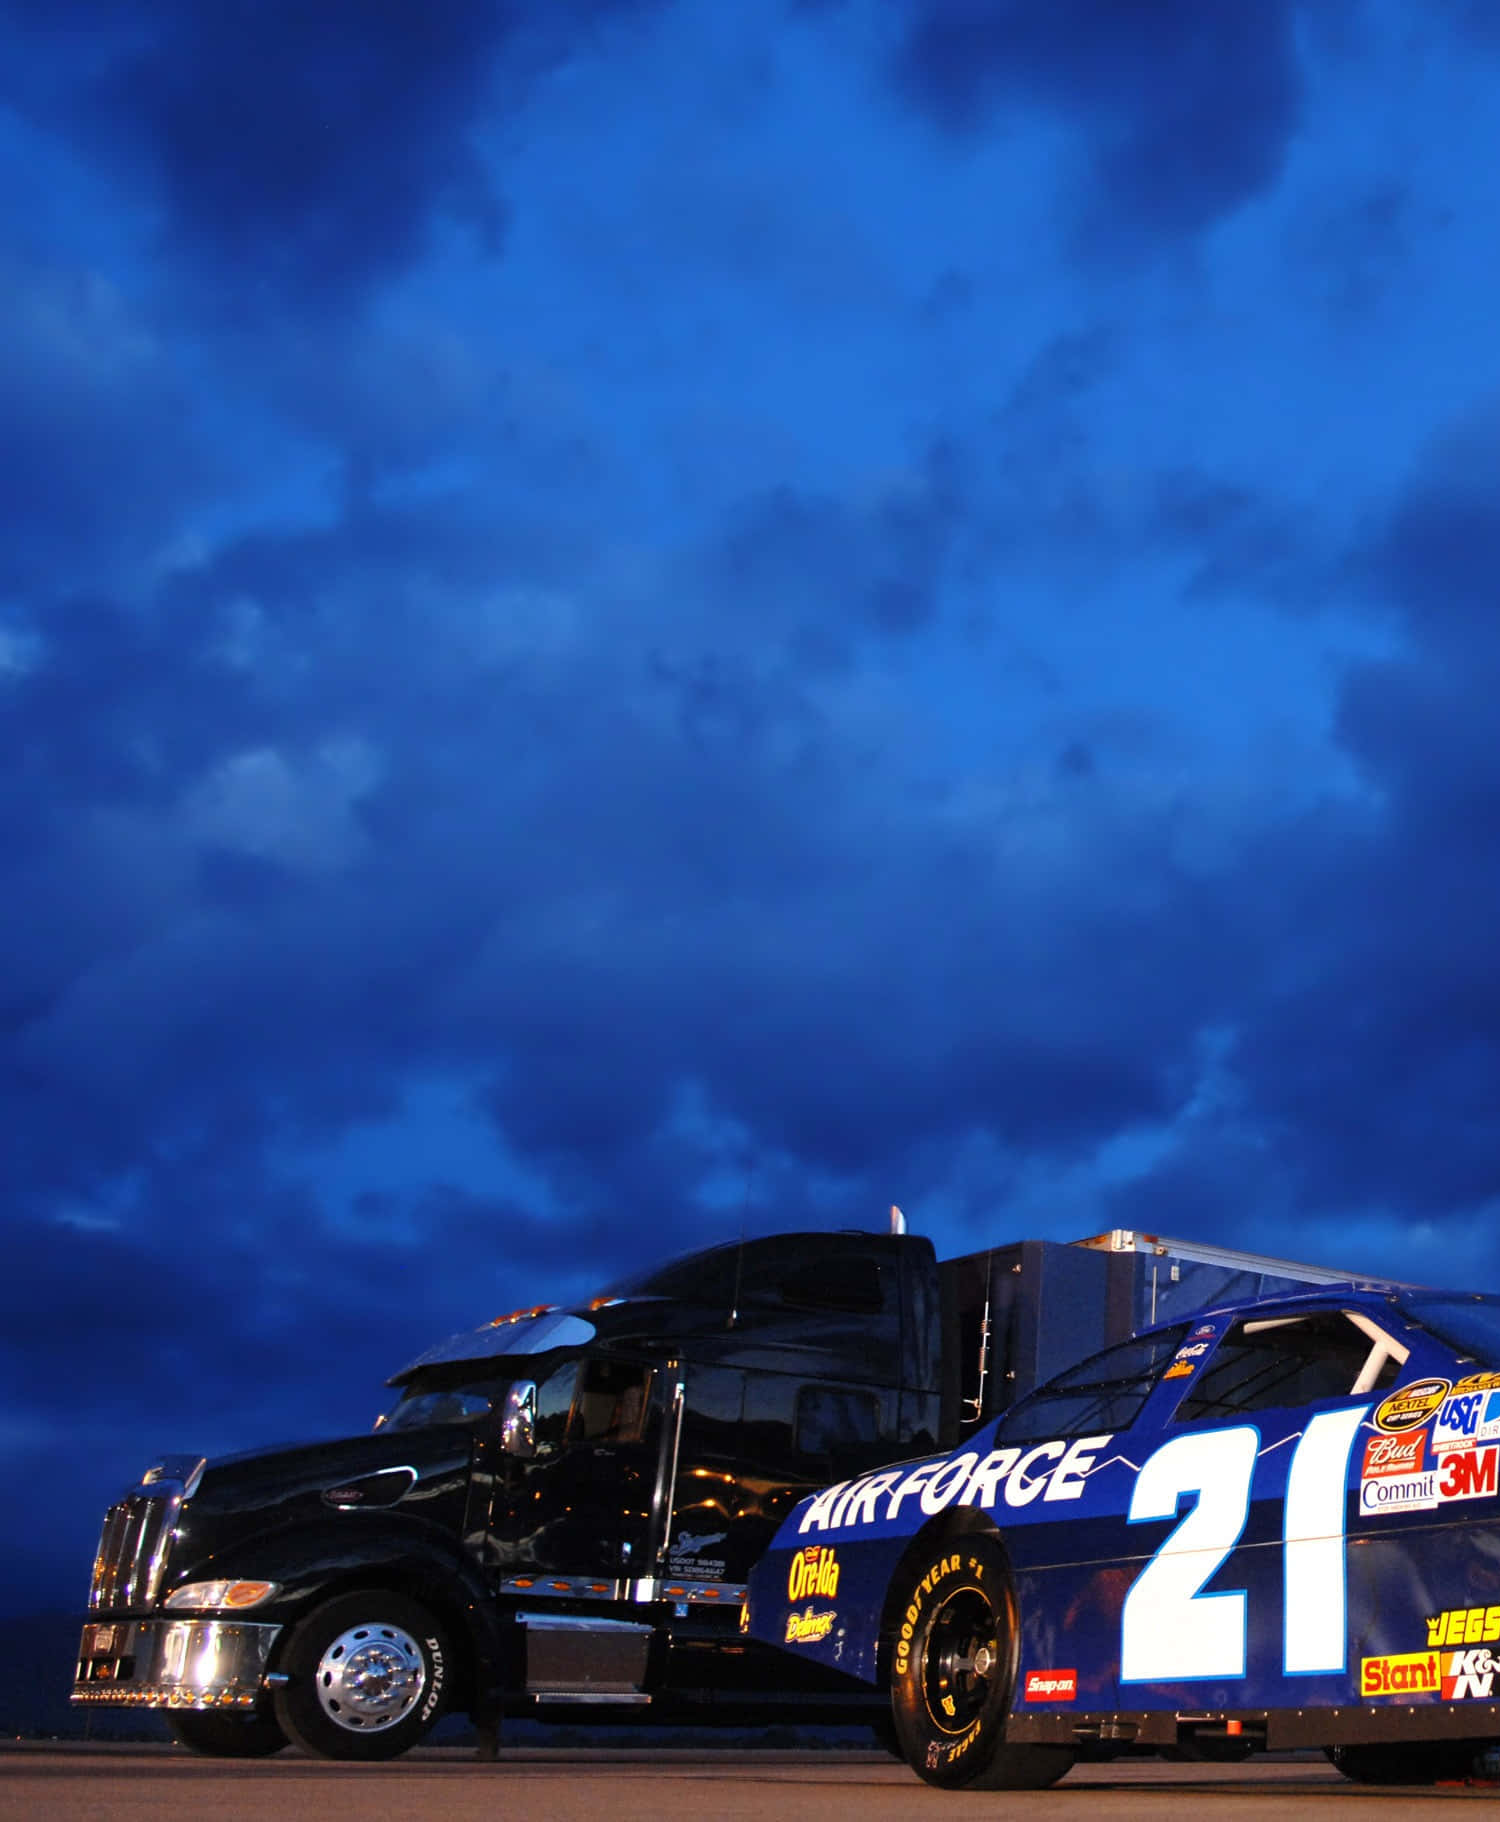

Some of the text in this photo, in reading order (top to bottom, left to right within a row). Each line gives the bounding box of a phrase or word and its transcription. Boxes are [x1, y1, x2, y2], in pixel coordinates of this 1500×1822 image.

[1388, 1398, 1430, 1413] NEXTEL
[1440, 1393, 1484, 1435] USG
[1367, 1434, 1425, 1466] Bud
[797, 1434, 1114, 1534] AIR FORCE
[1362, 1474, 1435, 1509] Commit
[1439, 1447, 1498, 1497] 3M
[1120, 1402, 1374, 1685] 21
[895, 1554, 961, 1675] GOODYEAR
[422, 1637, 444, 1721] DUNLOP
[1027, 1676, 1074, 1695] Snap-on
[1364, 1655, 1437, 1692] Stant
